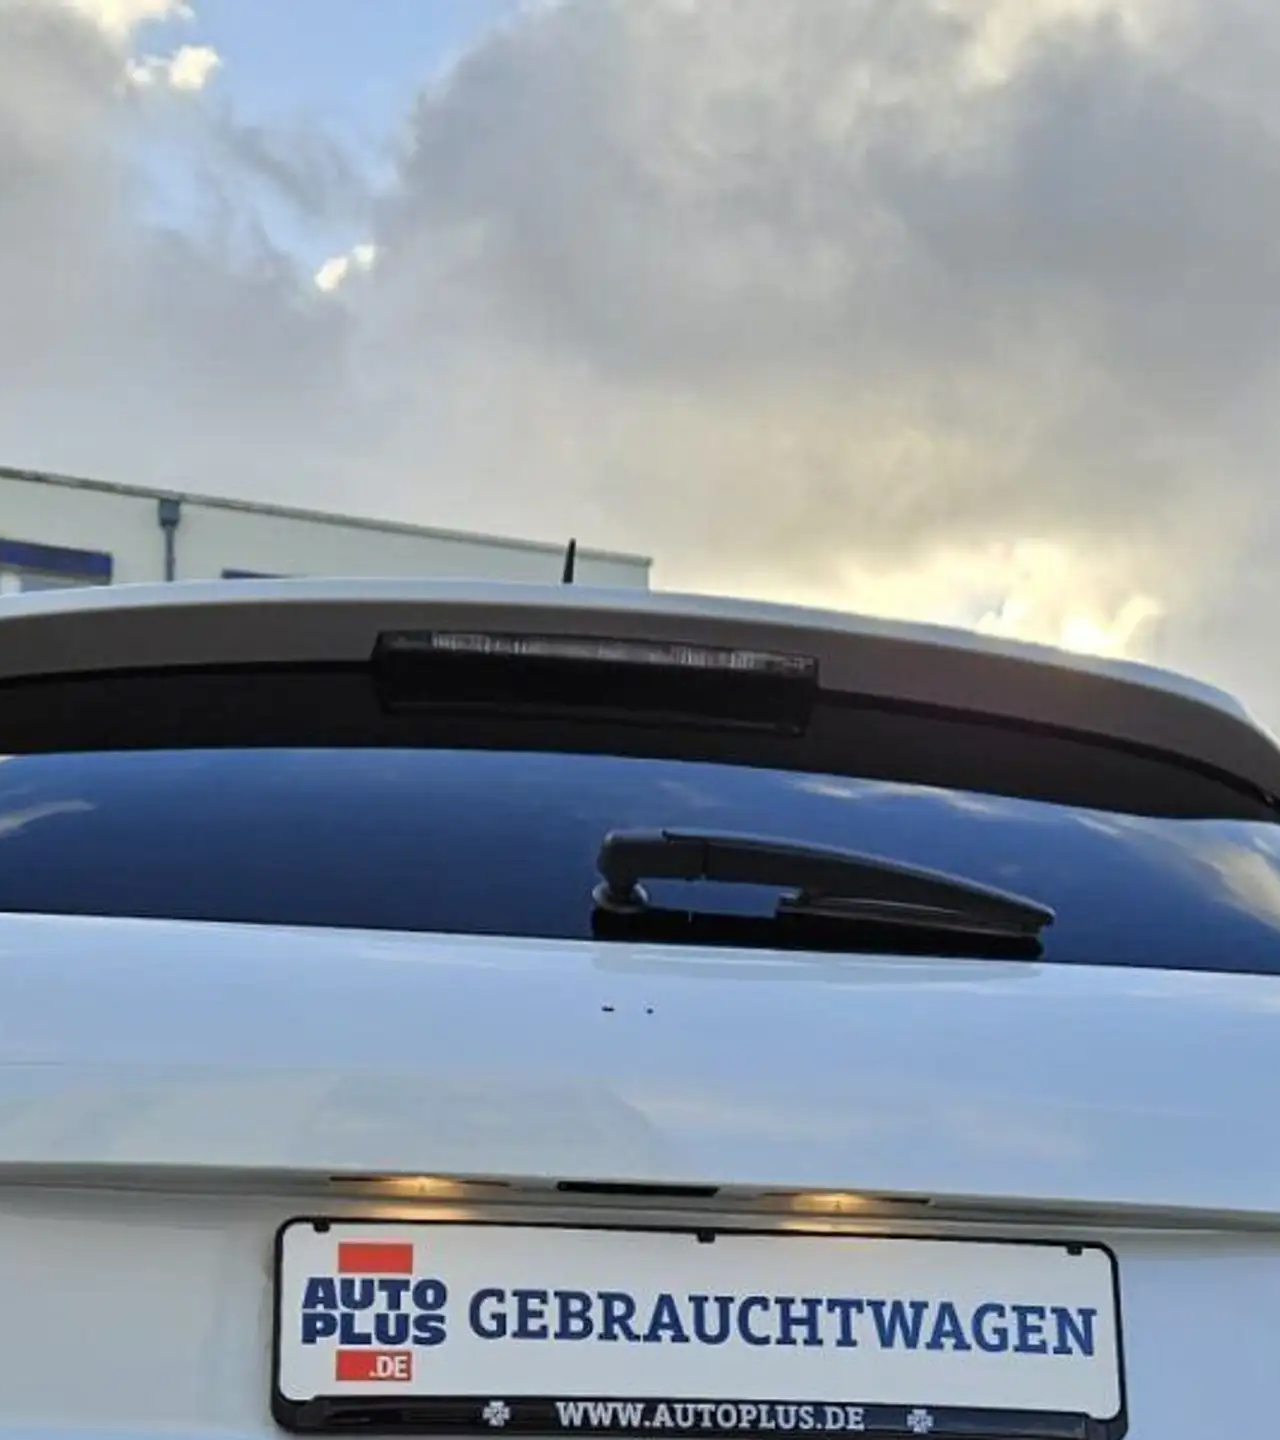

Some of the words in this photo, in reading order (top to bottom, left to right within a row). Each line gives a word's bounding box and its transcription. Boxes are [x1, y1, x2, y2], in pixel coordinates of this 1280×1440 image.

[302, 1276, 448, 1312] AUTO
[301, 1310, 447, 1347] PLUS
[468, 1287, 1098, 1357] GEBRAUCHTWAGEN
[369, 1355, 409, 1379] .DE
[555, 1399, 866, 1432] WWW.AUTOPLUS.DE
